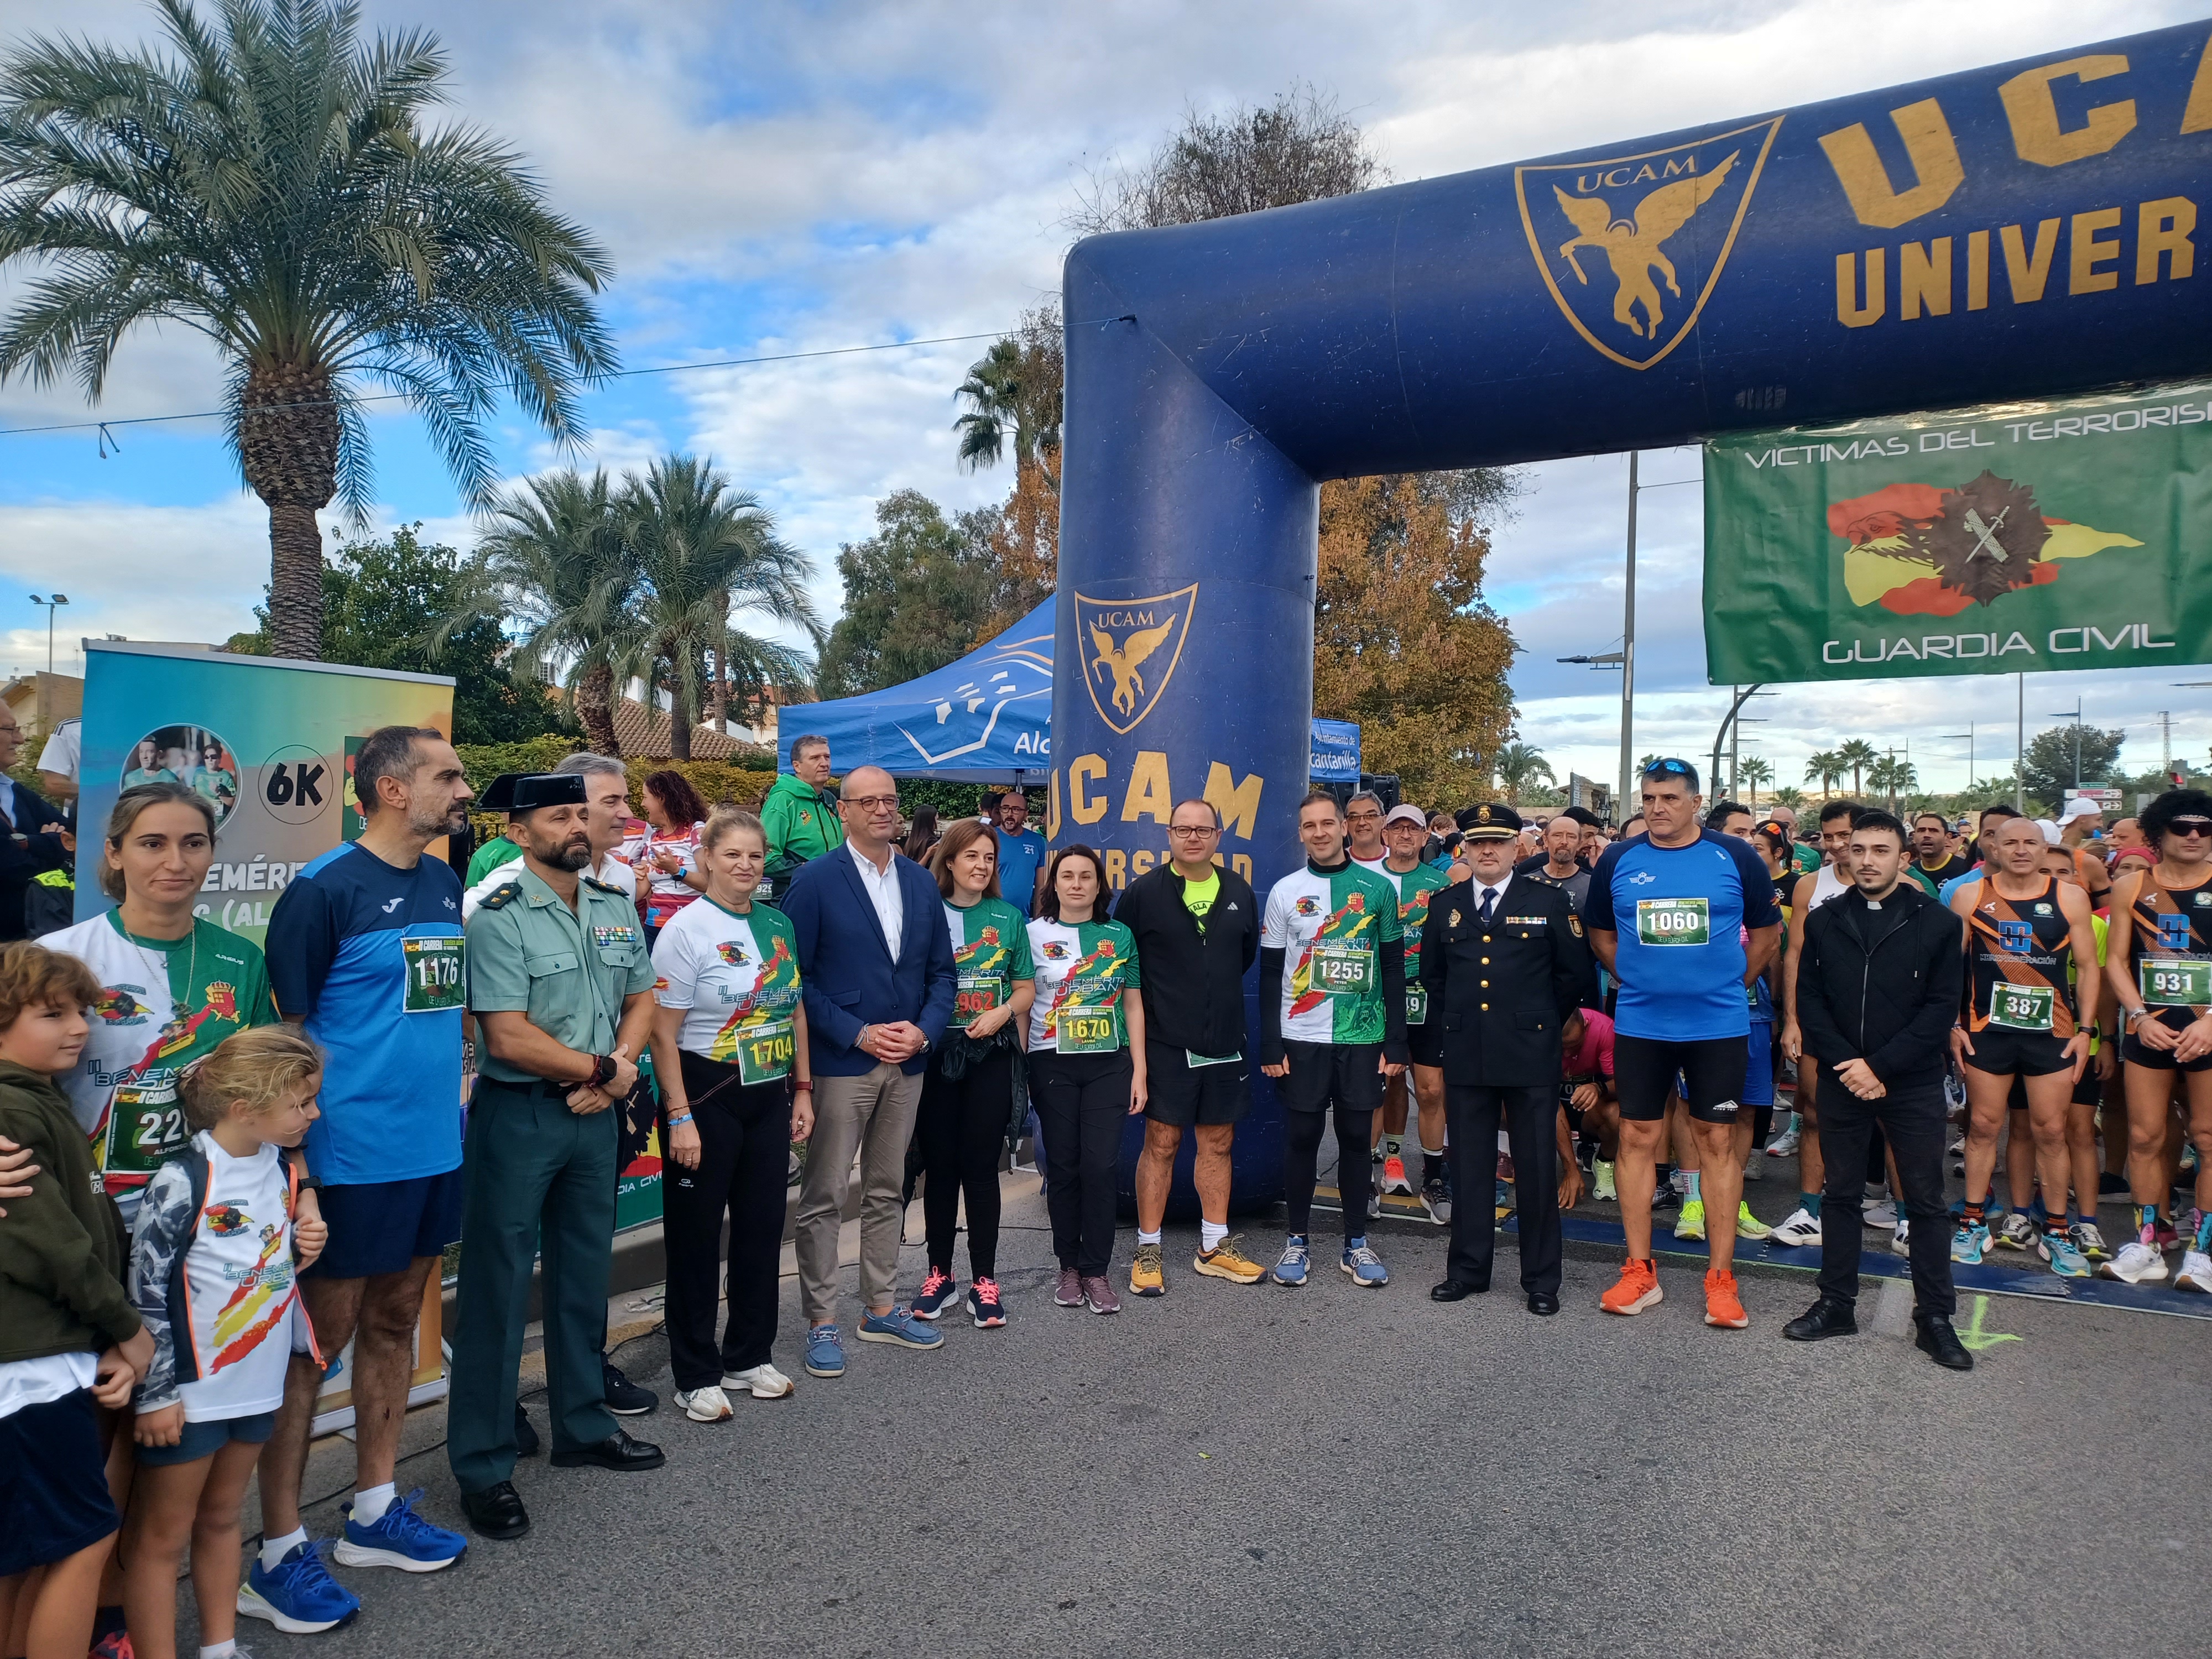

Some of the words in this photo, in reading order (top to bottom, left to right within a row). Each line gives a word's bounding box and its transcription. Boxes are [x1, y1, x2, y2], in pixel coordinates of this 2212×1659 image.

[1578, 155, 1697, 192] UCAM
[1836, 196, 2197, 328] UNIVER
[1744, 437, 1910, 469] VICTIMAS
[1920, 428, 1995, 453] DEL
[1098, 610, 1154, 628] UCAM
[1823, 631, 2036, 664] GUARDIA
[2050, 623, 2176, 653] CIVIL
[1314, 731, 1348, 745] Ayuntamiento
[1349, 734, 1355, 745] de
[267, 762, 325, 806] 6K
[1647, 912, 1698, 930] 1060
[415, 957, 458, 986] 1176
[1320, 961, 1363, 980] 1255
[2155, 973, 2192, 991] 931
[2007, 997, 2042, 1015] 387
[755, 1025, 776, 1037] CARRERA
[1066, 1019, 1110, 1038] 1670
[750, 1035, 792, 1065] 1704
[87, 1059, 101, 1074] II
[154, 1142, 188, 1155] ALFONSO
